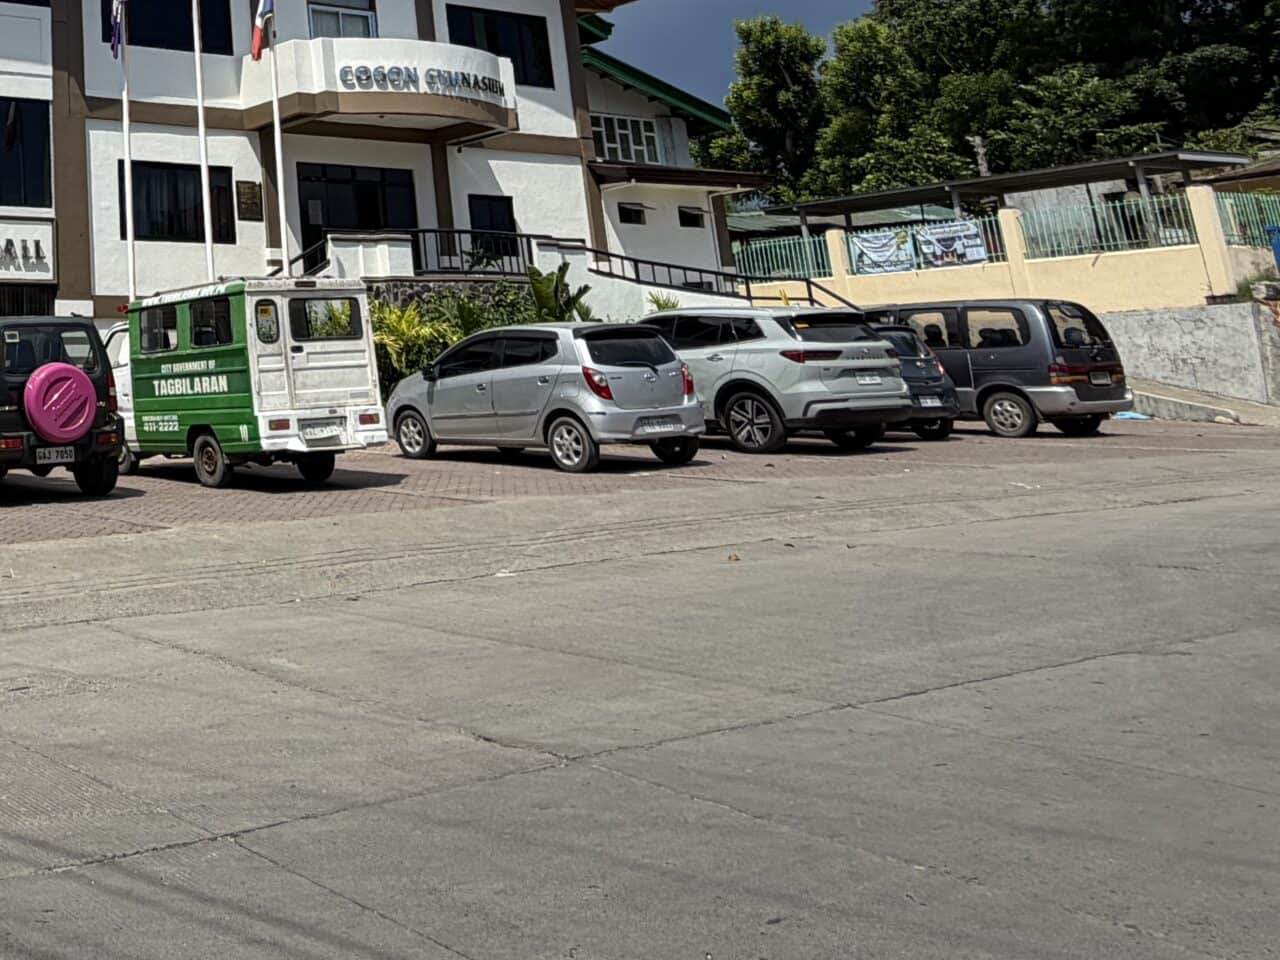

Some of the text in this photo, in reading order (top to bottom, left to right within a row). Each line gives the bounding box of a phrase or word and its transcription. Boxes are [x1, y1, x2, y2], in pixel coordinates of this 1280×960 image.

[339, 65, 506, 97] COGON GYMNASIUM
[161, 359, 216, 374] CITY GOVERNMENT OF
[152, 375, 228, 396] TAGBILARAN
